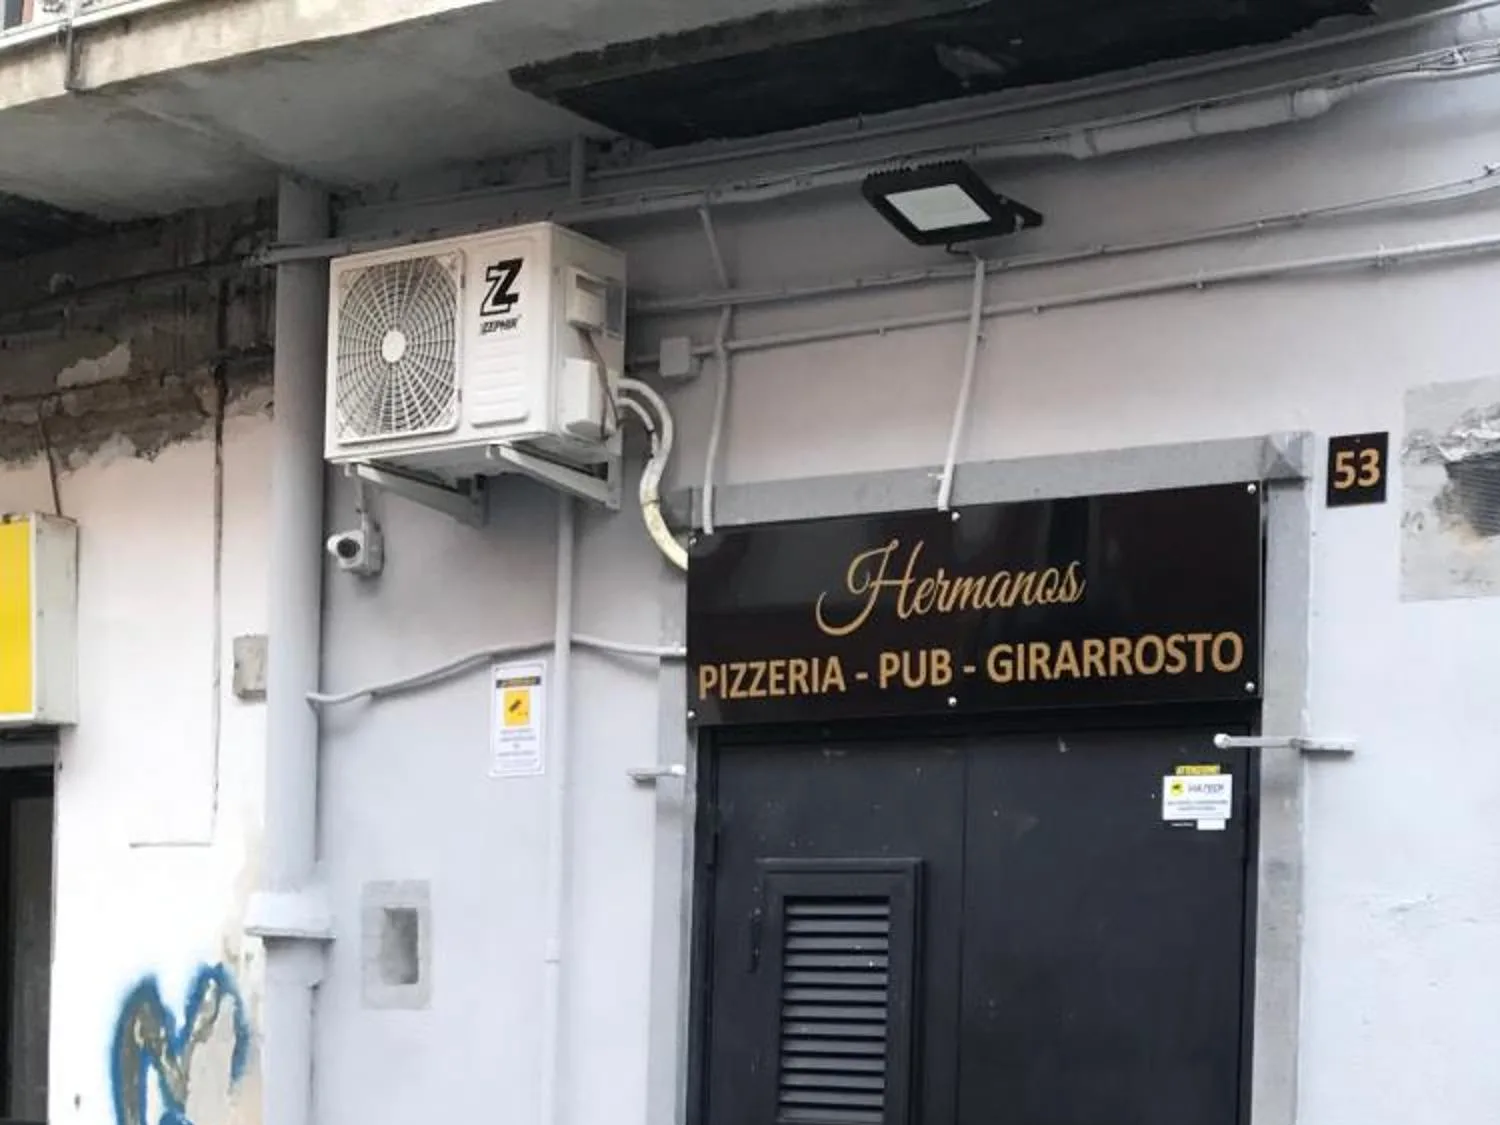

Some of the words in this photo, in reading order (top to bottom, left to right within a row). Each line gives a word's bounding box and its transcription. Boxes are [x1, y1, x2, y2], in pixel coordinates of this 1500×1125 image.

[1333, 447, 1380, 489] 53
[816, 538, 1087, 636] Hermanos
[699, 655, 846, 700] PIZZERIA
[879, 648, 953, 689] PUB
[987, 630, 1245, 684] GIRARROSTO
